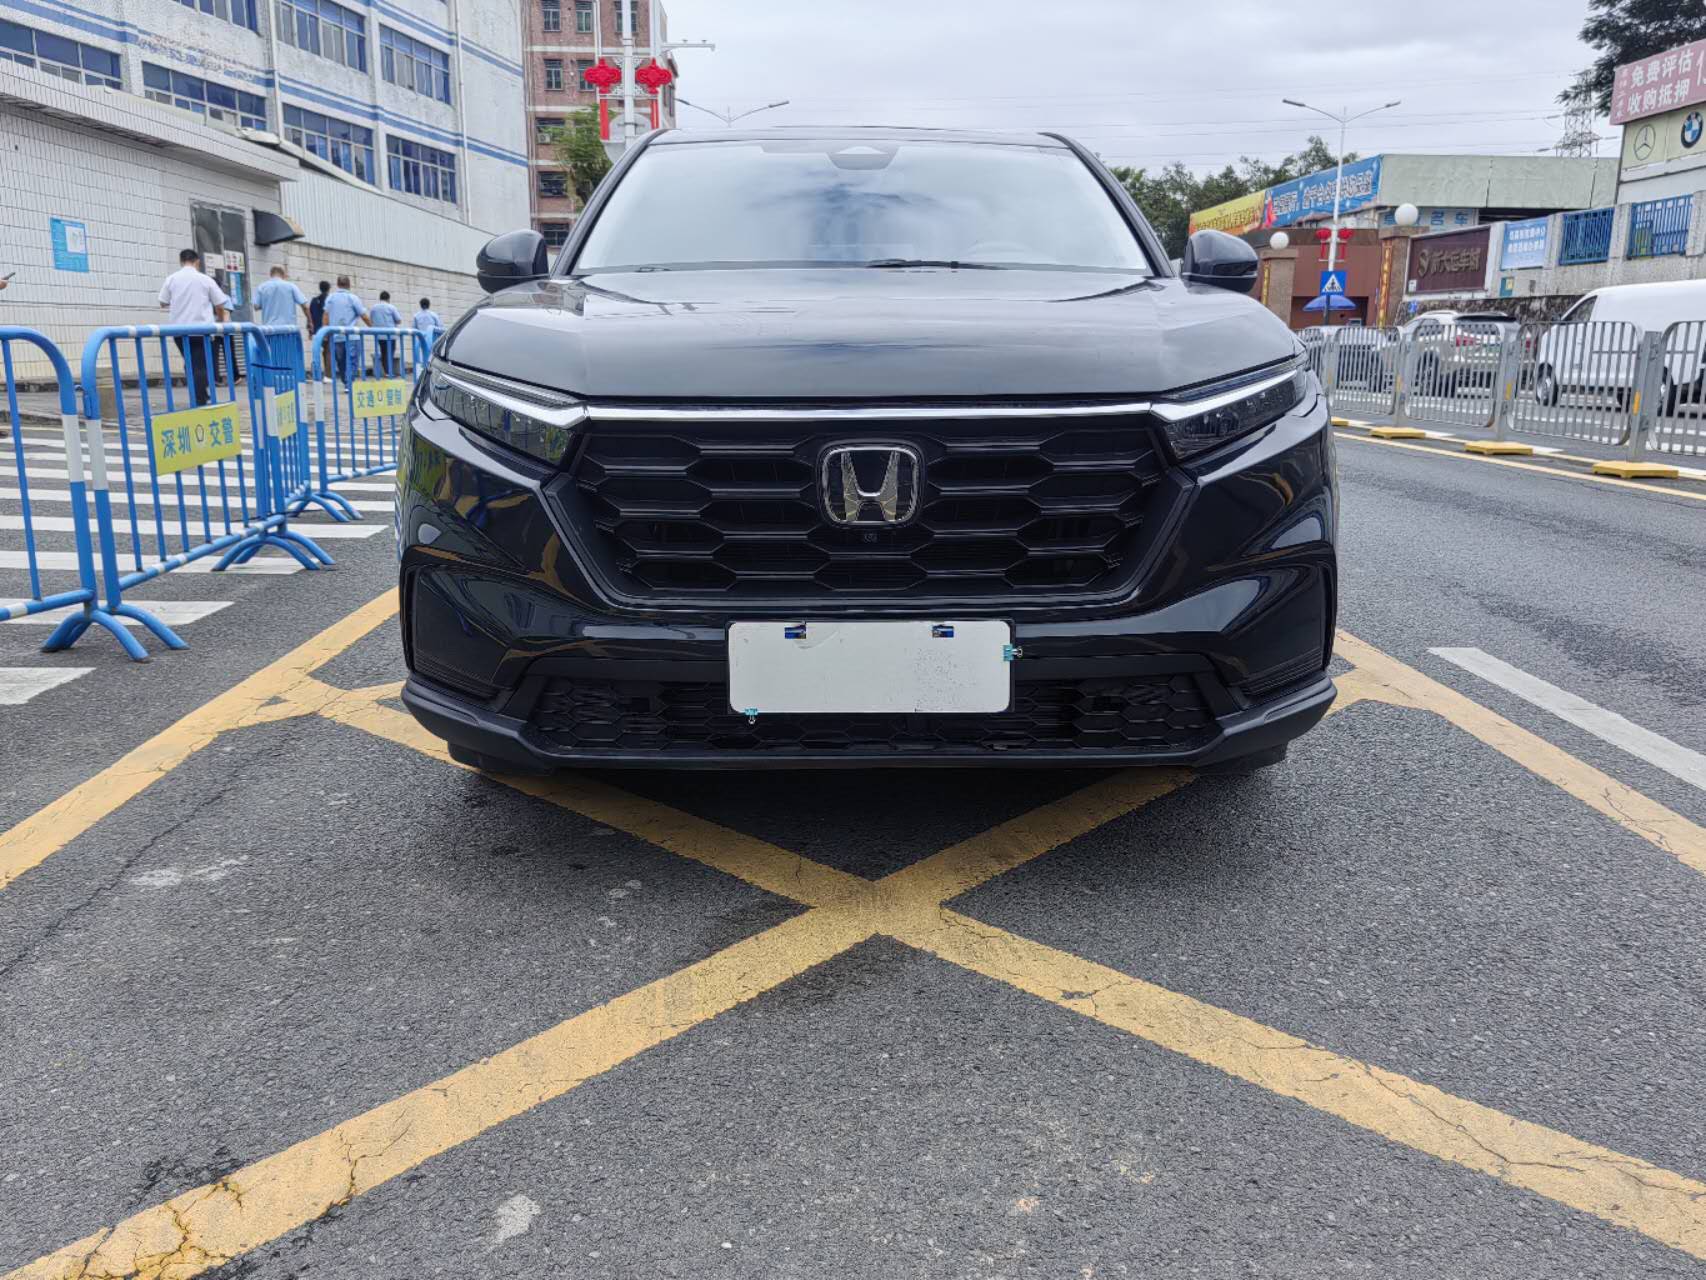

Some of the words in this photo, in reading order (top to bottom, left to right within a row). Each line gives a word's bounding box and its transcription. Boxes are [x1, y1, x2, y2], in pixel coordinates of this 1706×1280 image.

[1631, 48, 1695, 89] 免费评估
[1627, 79, 1691, 115] 收购抵押
[161, 425, 192, 459] 深圳
[209, 416, 234, 448] 交警
